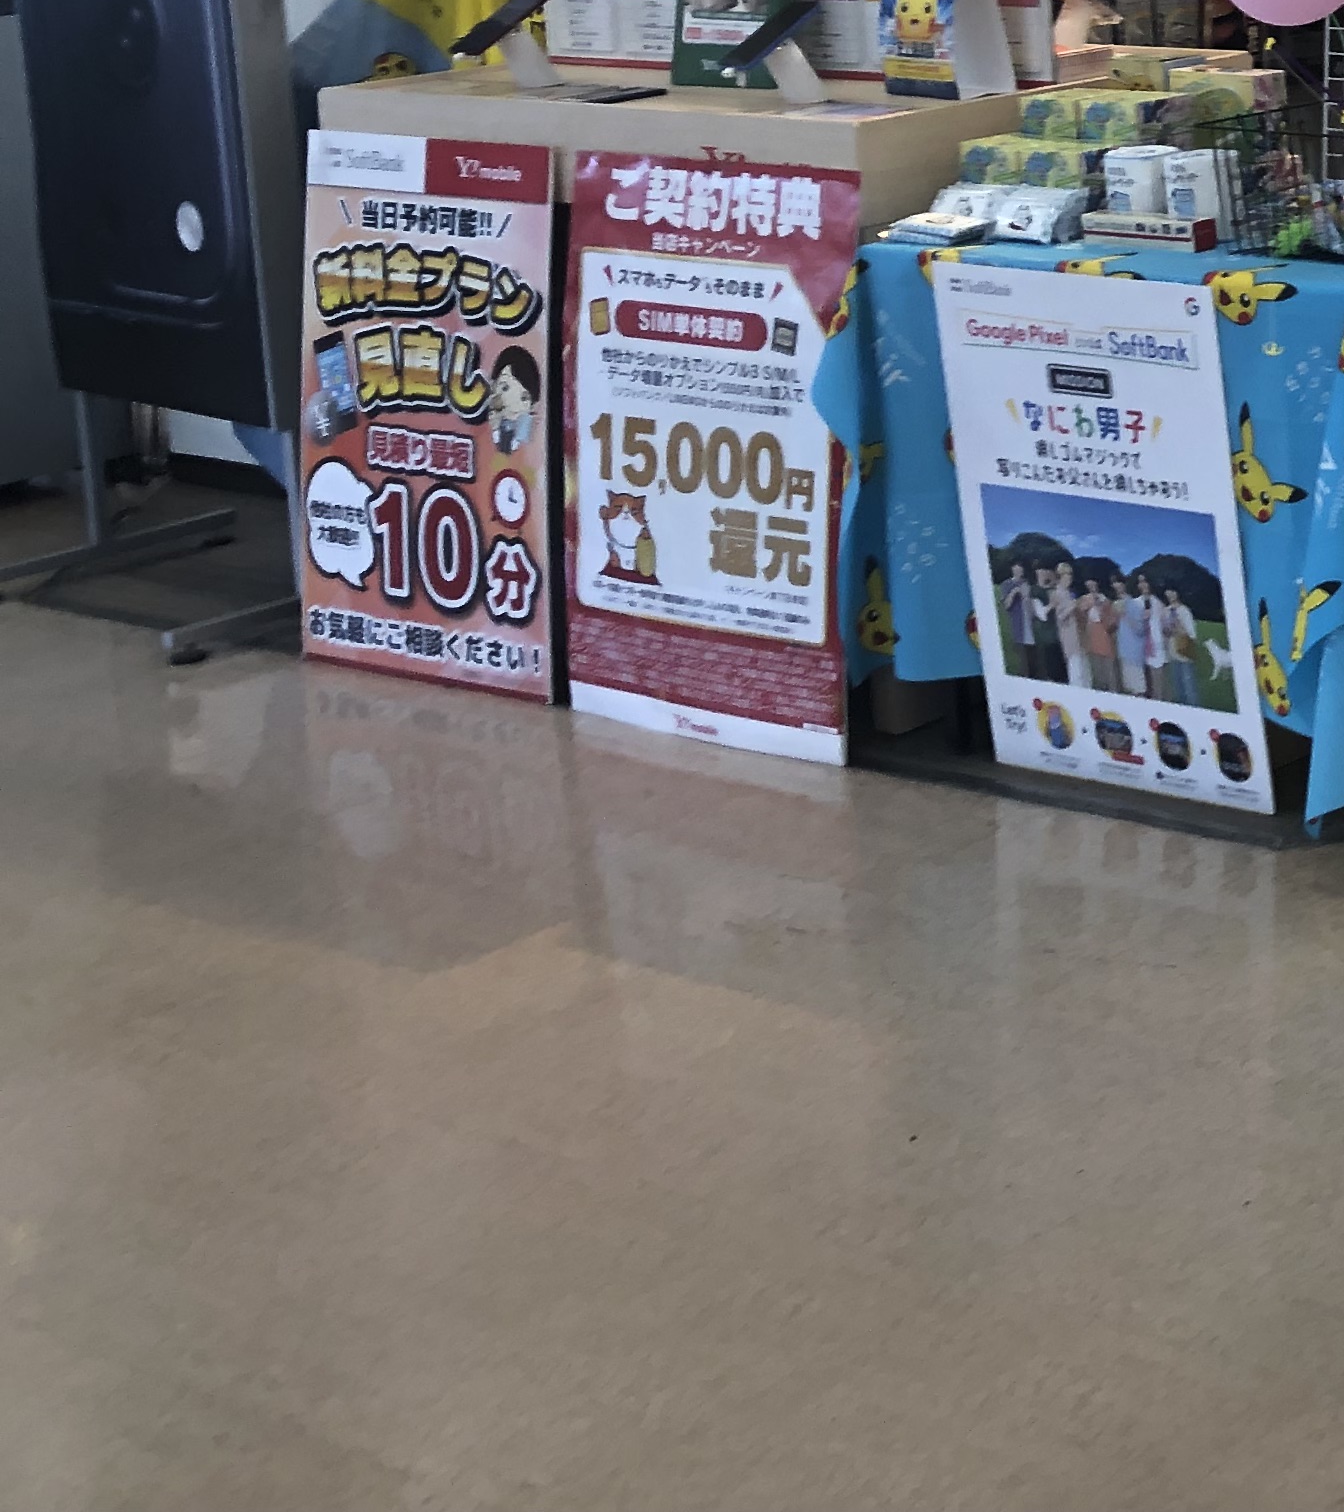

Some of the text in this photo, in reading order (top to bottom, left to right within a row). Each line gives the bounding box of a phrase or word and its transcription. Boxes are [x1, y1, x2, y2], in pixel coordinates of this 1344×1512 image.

[604, 165, 822, 241] ご契約特典
[965, 318, 1026, 346] Google
[590, 412, 816, 513] 15,000円
